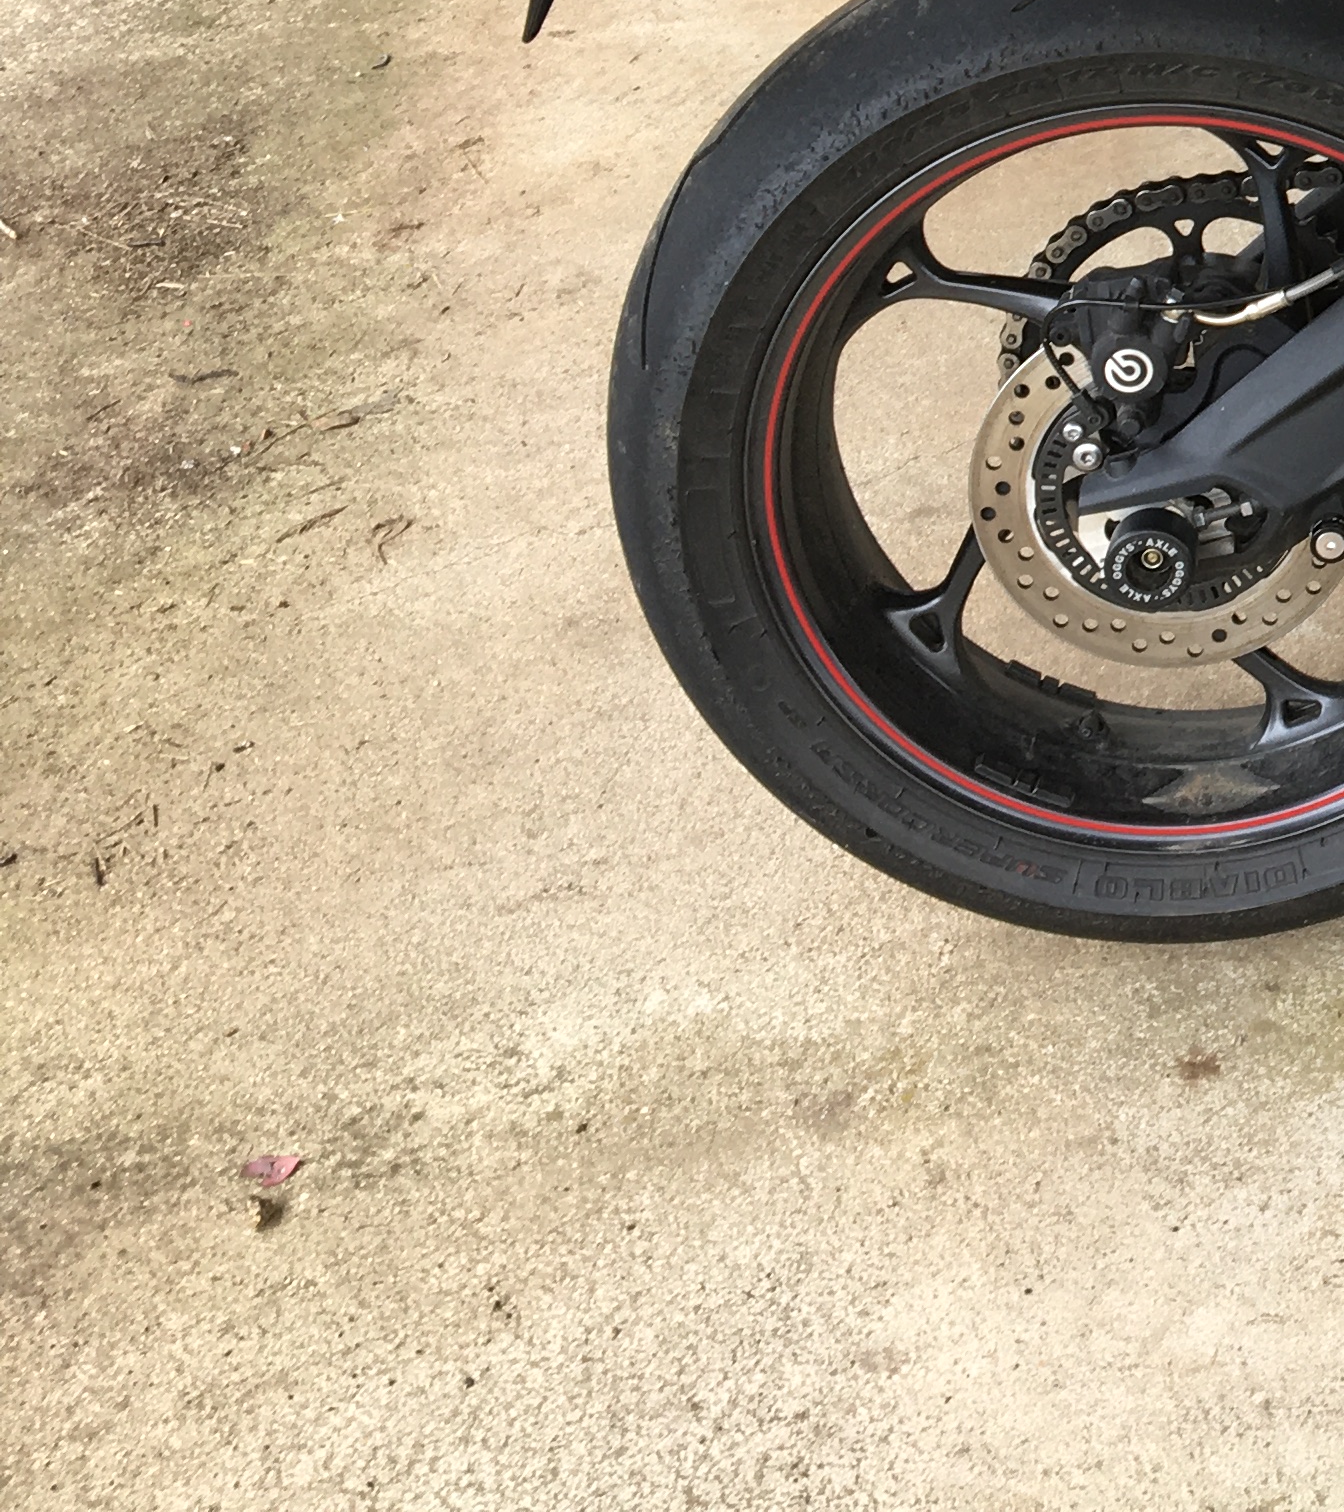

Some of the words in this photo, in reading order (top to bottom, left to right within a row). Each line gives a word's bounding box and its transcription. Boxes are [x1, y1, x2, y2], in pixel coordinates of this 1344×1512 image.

[1145, 537, 1178, 558] AXLE
[1118, 583, 1151, 603] AXLE
[1094, 862, 1299, 902] DIABLO
